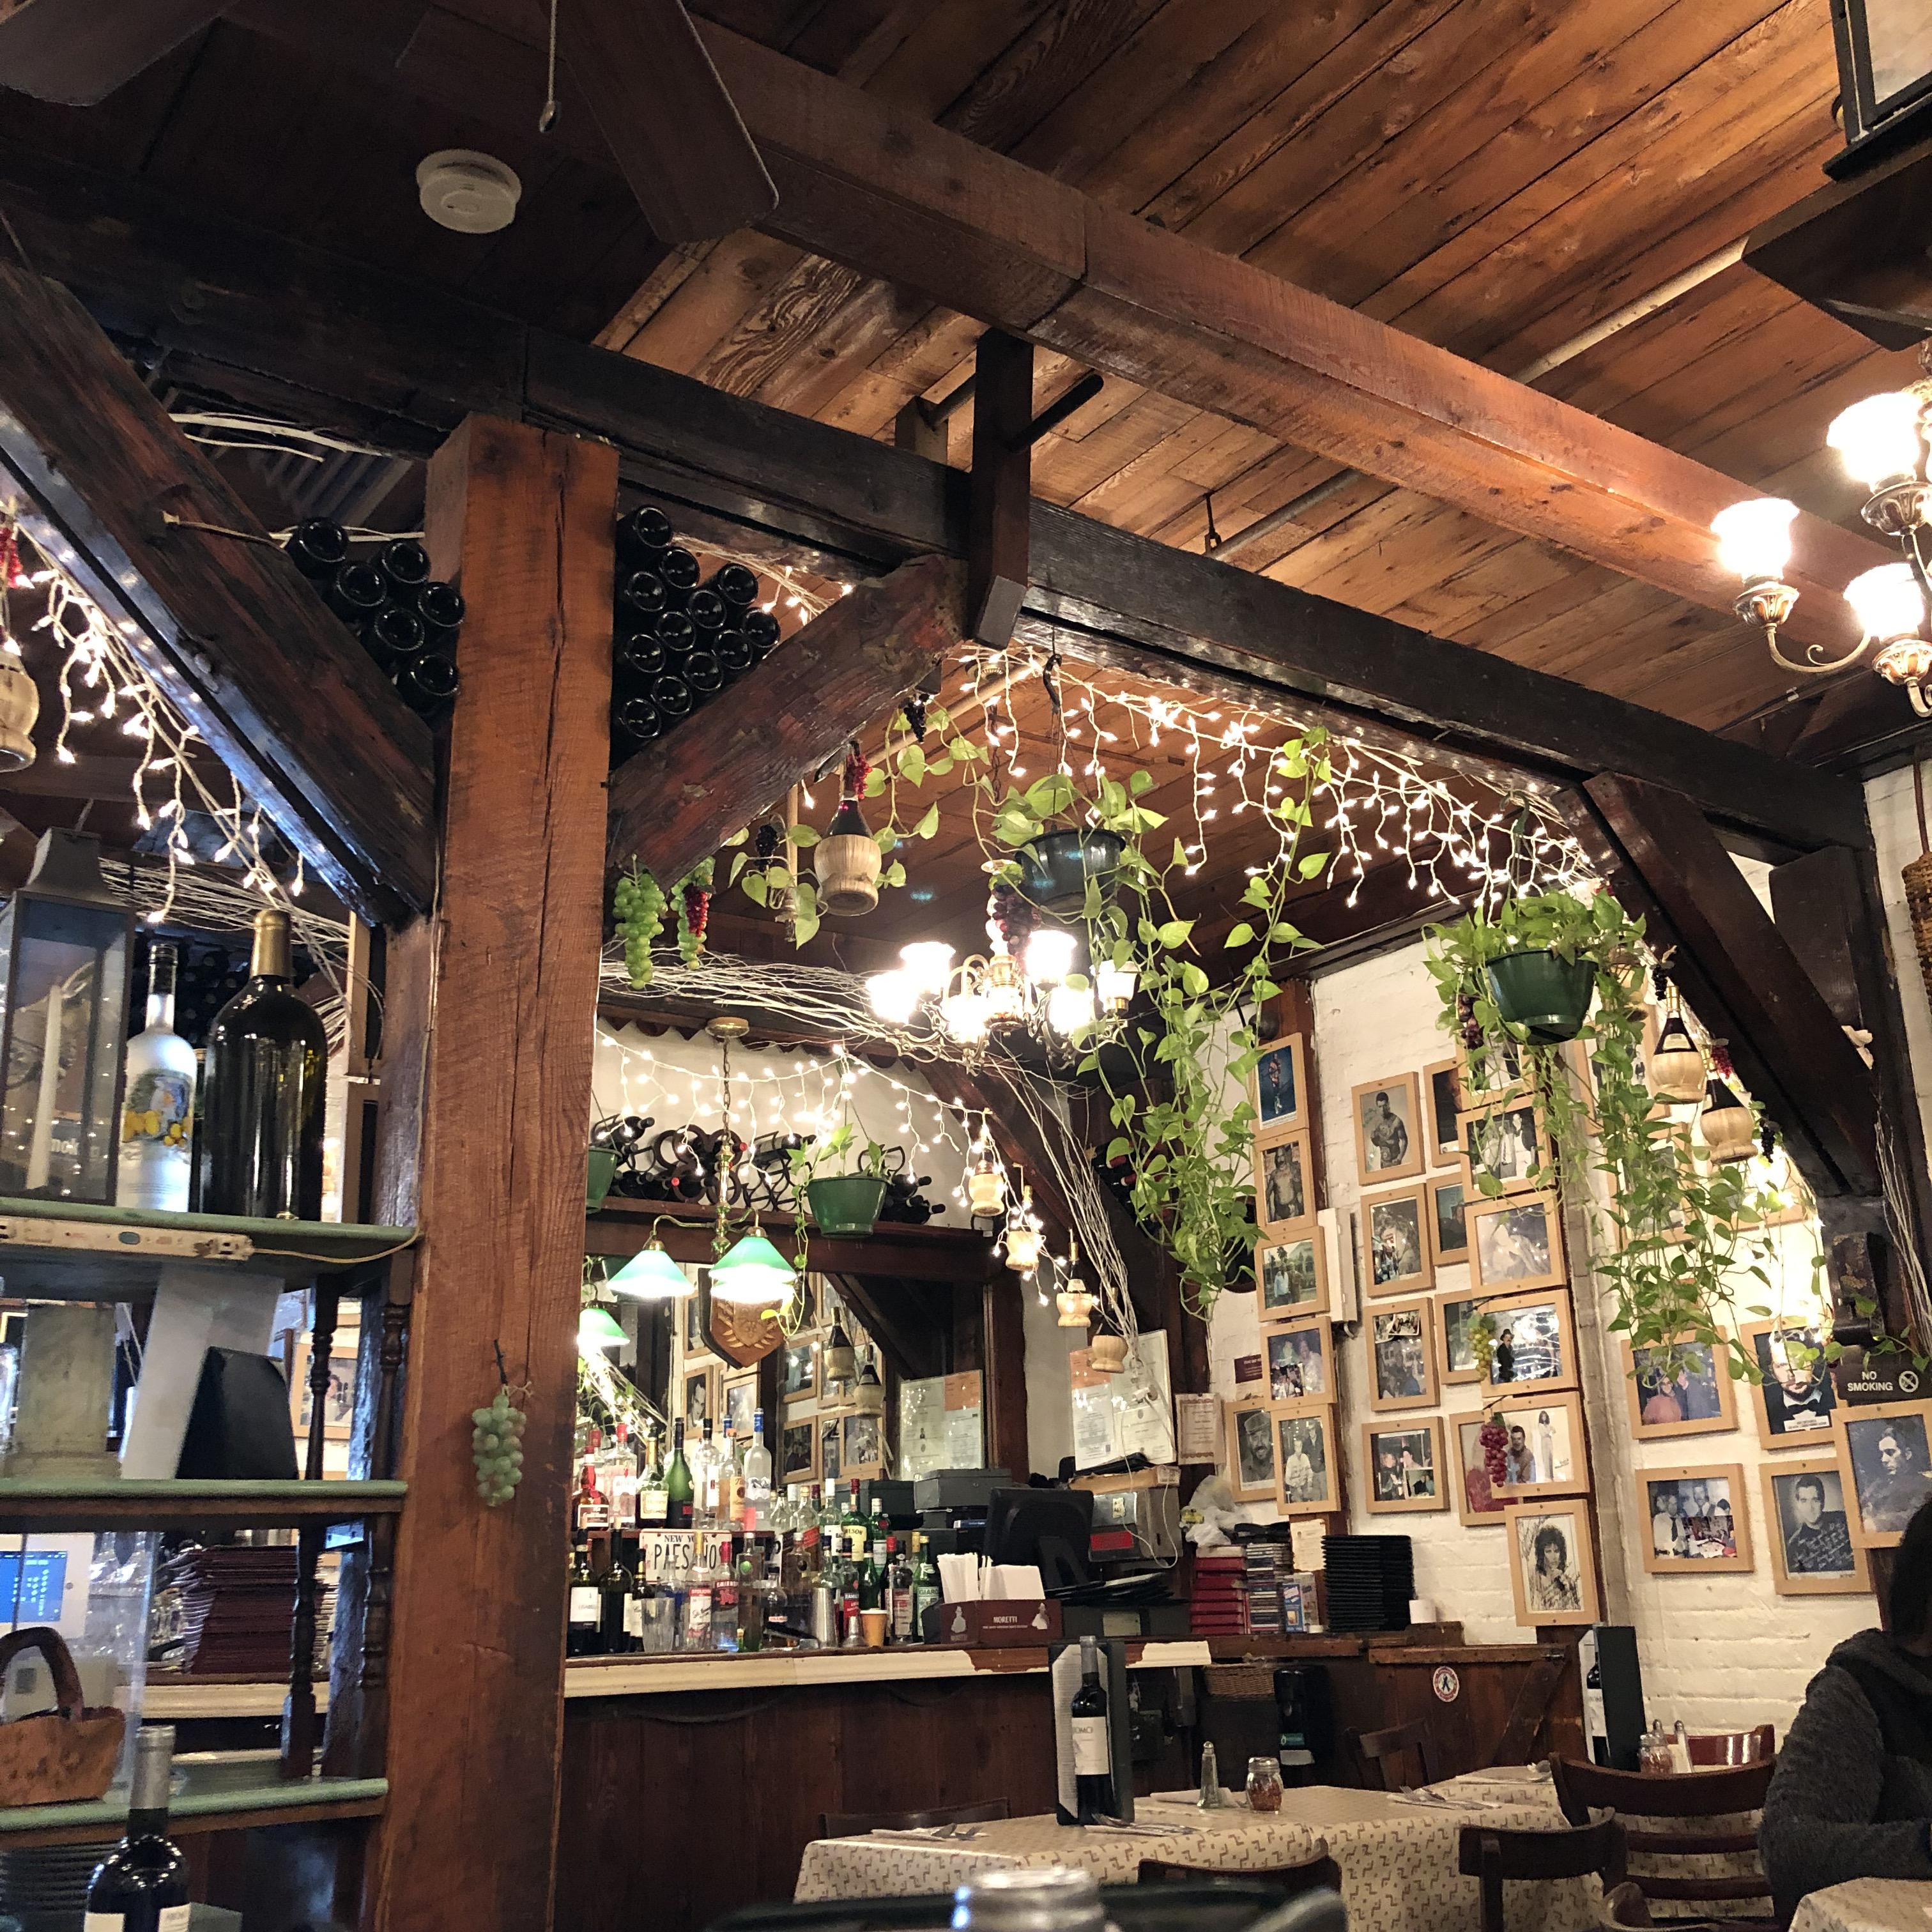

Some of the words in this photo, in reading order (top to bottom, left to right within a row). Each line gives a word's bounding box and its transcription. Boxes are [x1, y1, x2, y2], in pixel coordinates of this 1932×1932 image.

[1861, 1370, 1877, 1380] NO
[1847, 1382, 1894, 1392] SMOKING
[654, 1544, 717, 1570] PAESNO
